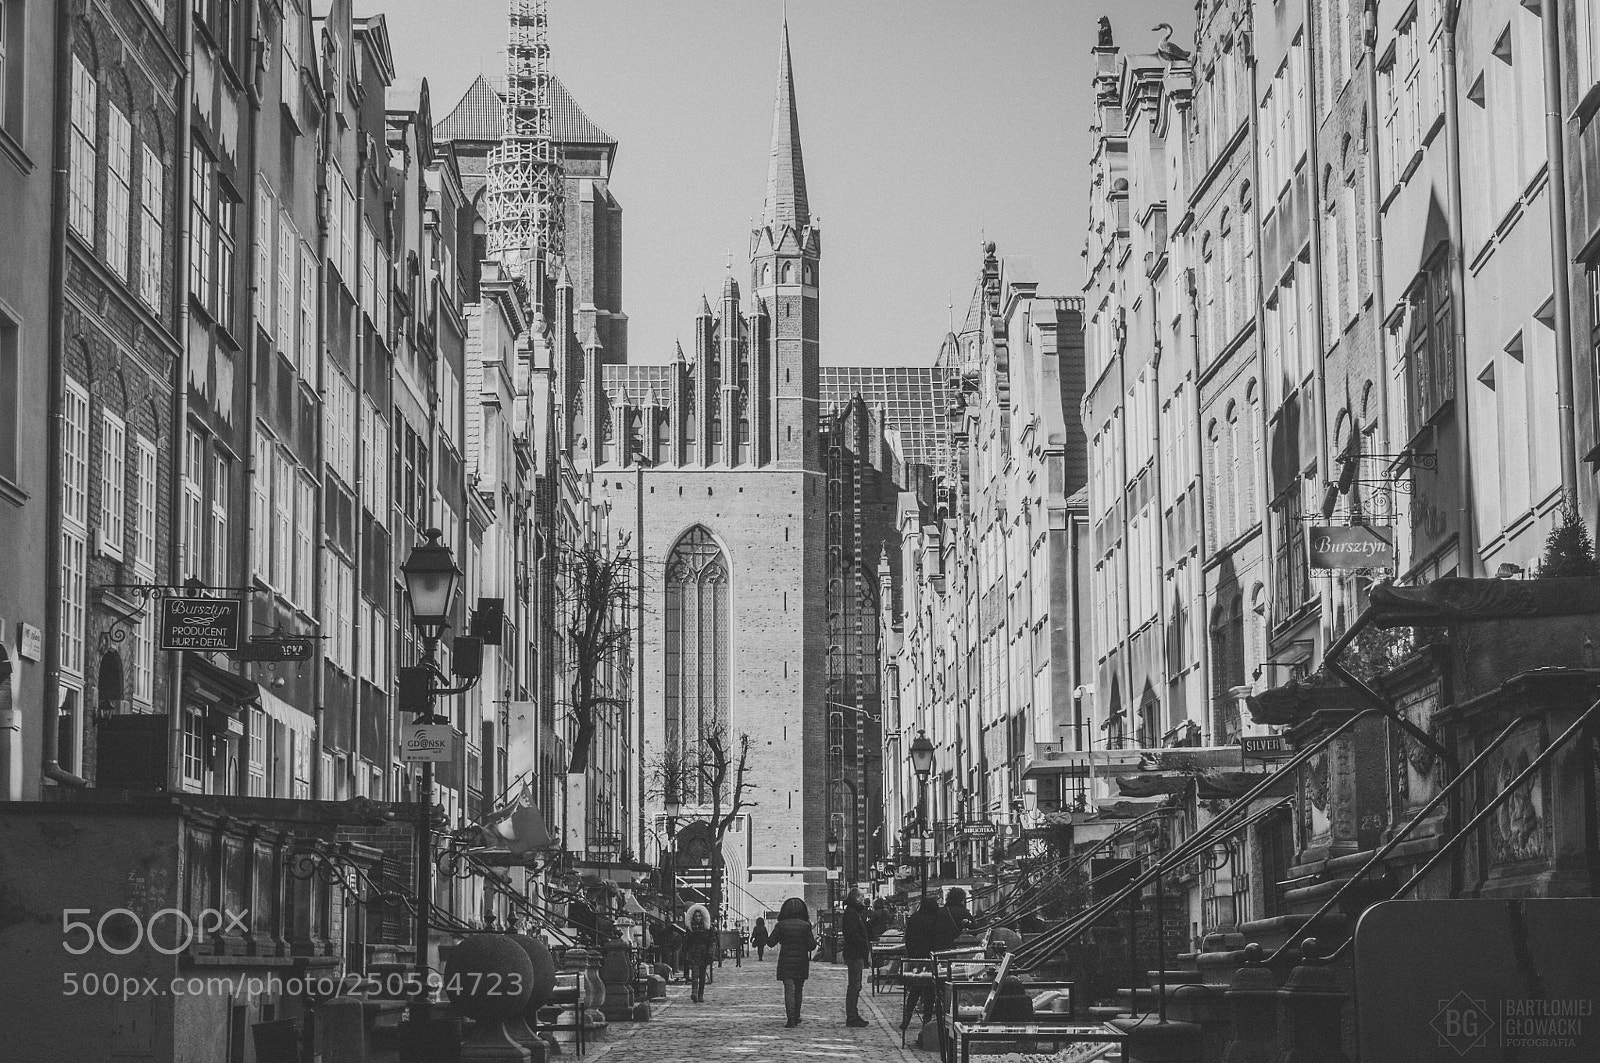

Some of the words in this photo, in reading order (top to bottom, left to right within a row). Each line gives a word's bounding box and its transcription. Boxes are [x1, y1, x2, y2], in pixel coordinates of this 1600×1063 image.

[1314, 536, 1387, 557] Bursztyn
[171, 600, 231, 619] Bursztyn
[172, 626, 228, 637] PRODUCENT
[1246, 739, 1280, 752] SILVER
